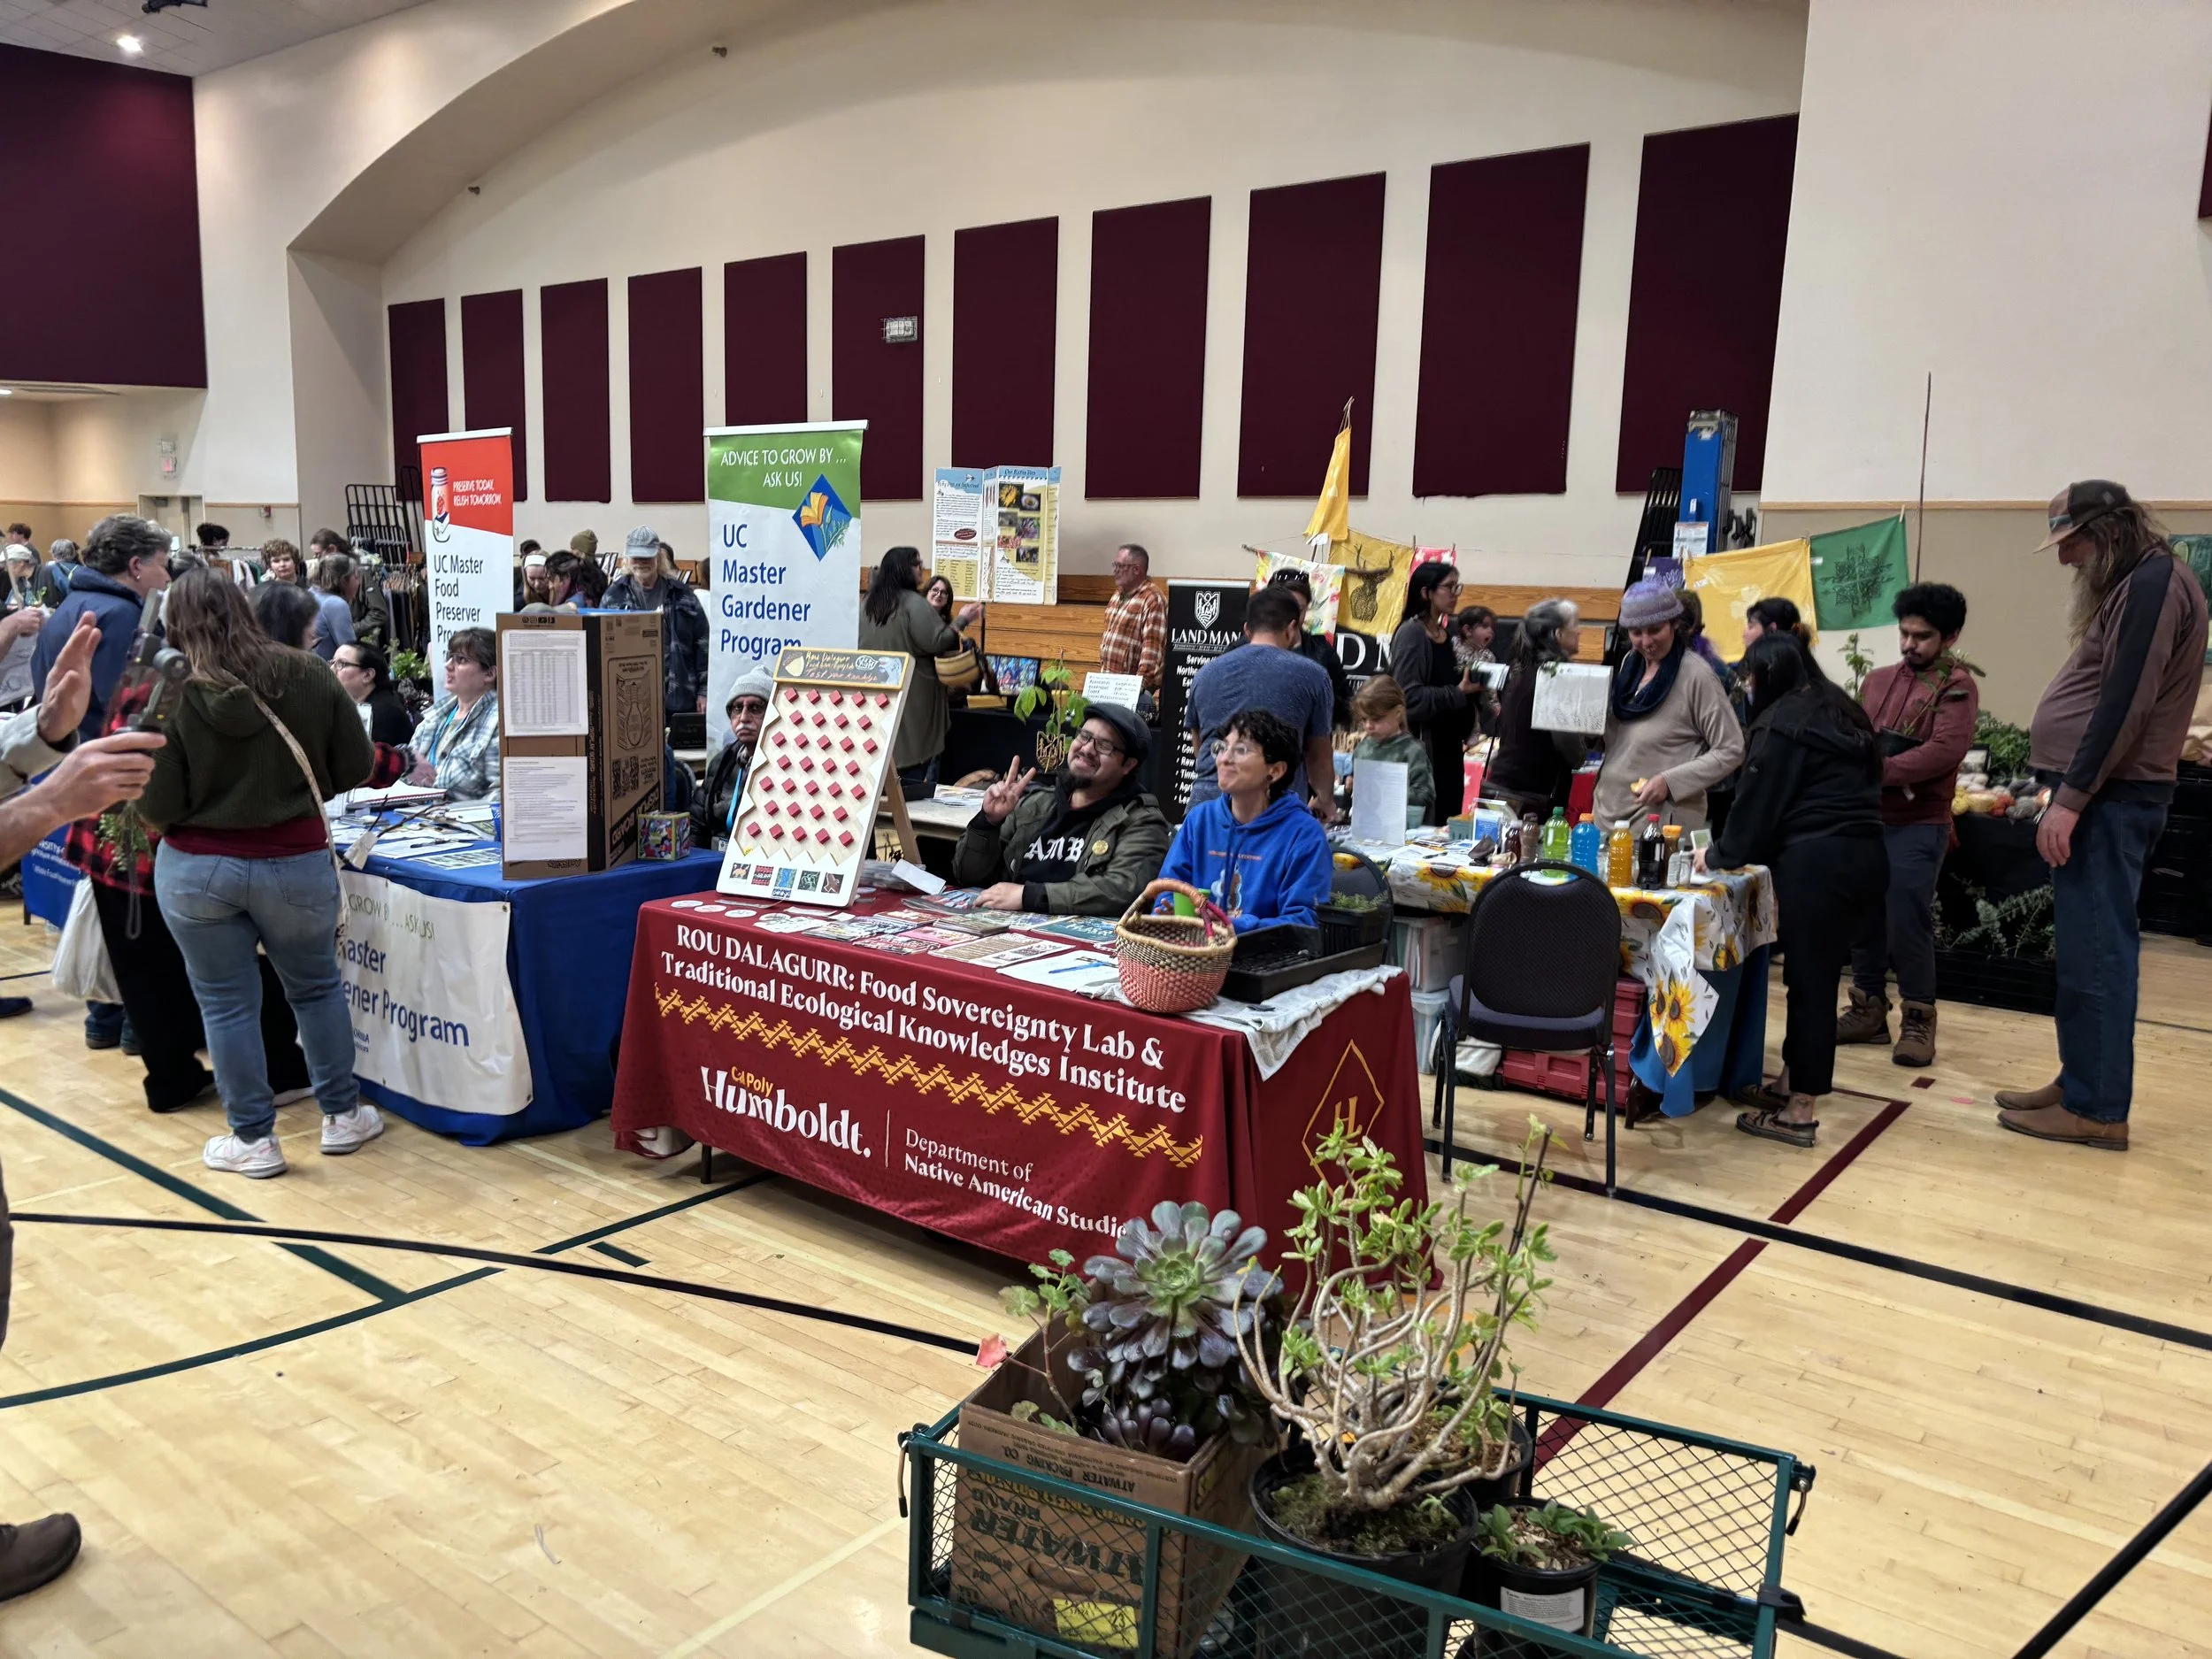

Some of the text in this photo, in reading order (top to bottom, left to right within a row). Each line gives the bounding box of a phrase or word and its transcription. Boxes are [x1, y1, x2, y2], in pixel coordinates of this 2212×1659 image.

[720, 449, 759, 466] ADVICE
[762, 449, 779, 465] TO
[780, 448, 817, 465] GROW
[819, 447, 833, 464] BY
[763, 471, 803, 488] ASK US!
[723, 523, 748, 549] UC
[434, 555, 484, 575] UC Master
[722, 559, 787, 585] Master
[434, 578, 459, 597] Food
[436, 602, 480, 623] Preserver
[722, 594, 811, 622] Gardener
[349, 894, 381, 918] GROW
[676, 924, 1164, 1071] ROU DALAGURR: Food Sovereignty Lab &
[383, 988, 470, 1048] Program
[660, 951, 1187, 1114] Traditional Ecological Knowledges Institute
[746, 1072, 774, 1098] Poly
[701, 1065, 872, 1158] Humboldt.
[905, 1127, 1034, 1183] Department of
[904, 1152, 1128, 1240] Native American Studie
[1082, 1470, 1136, 1494] ATWATER
